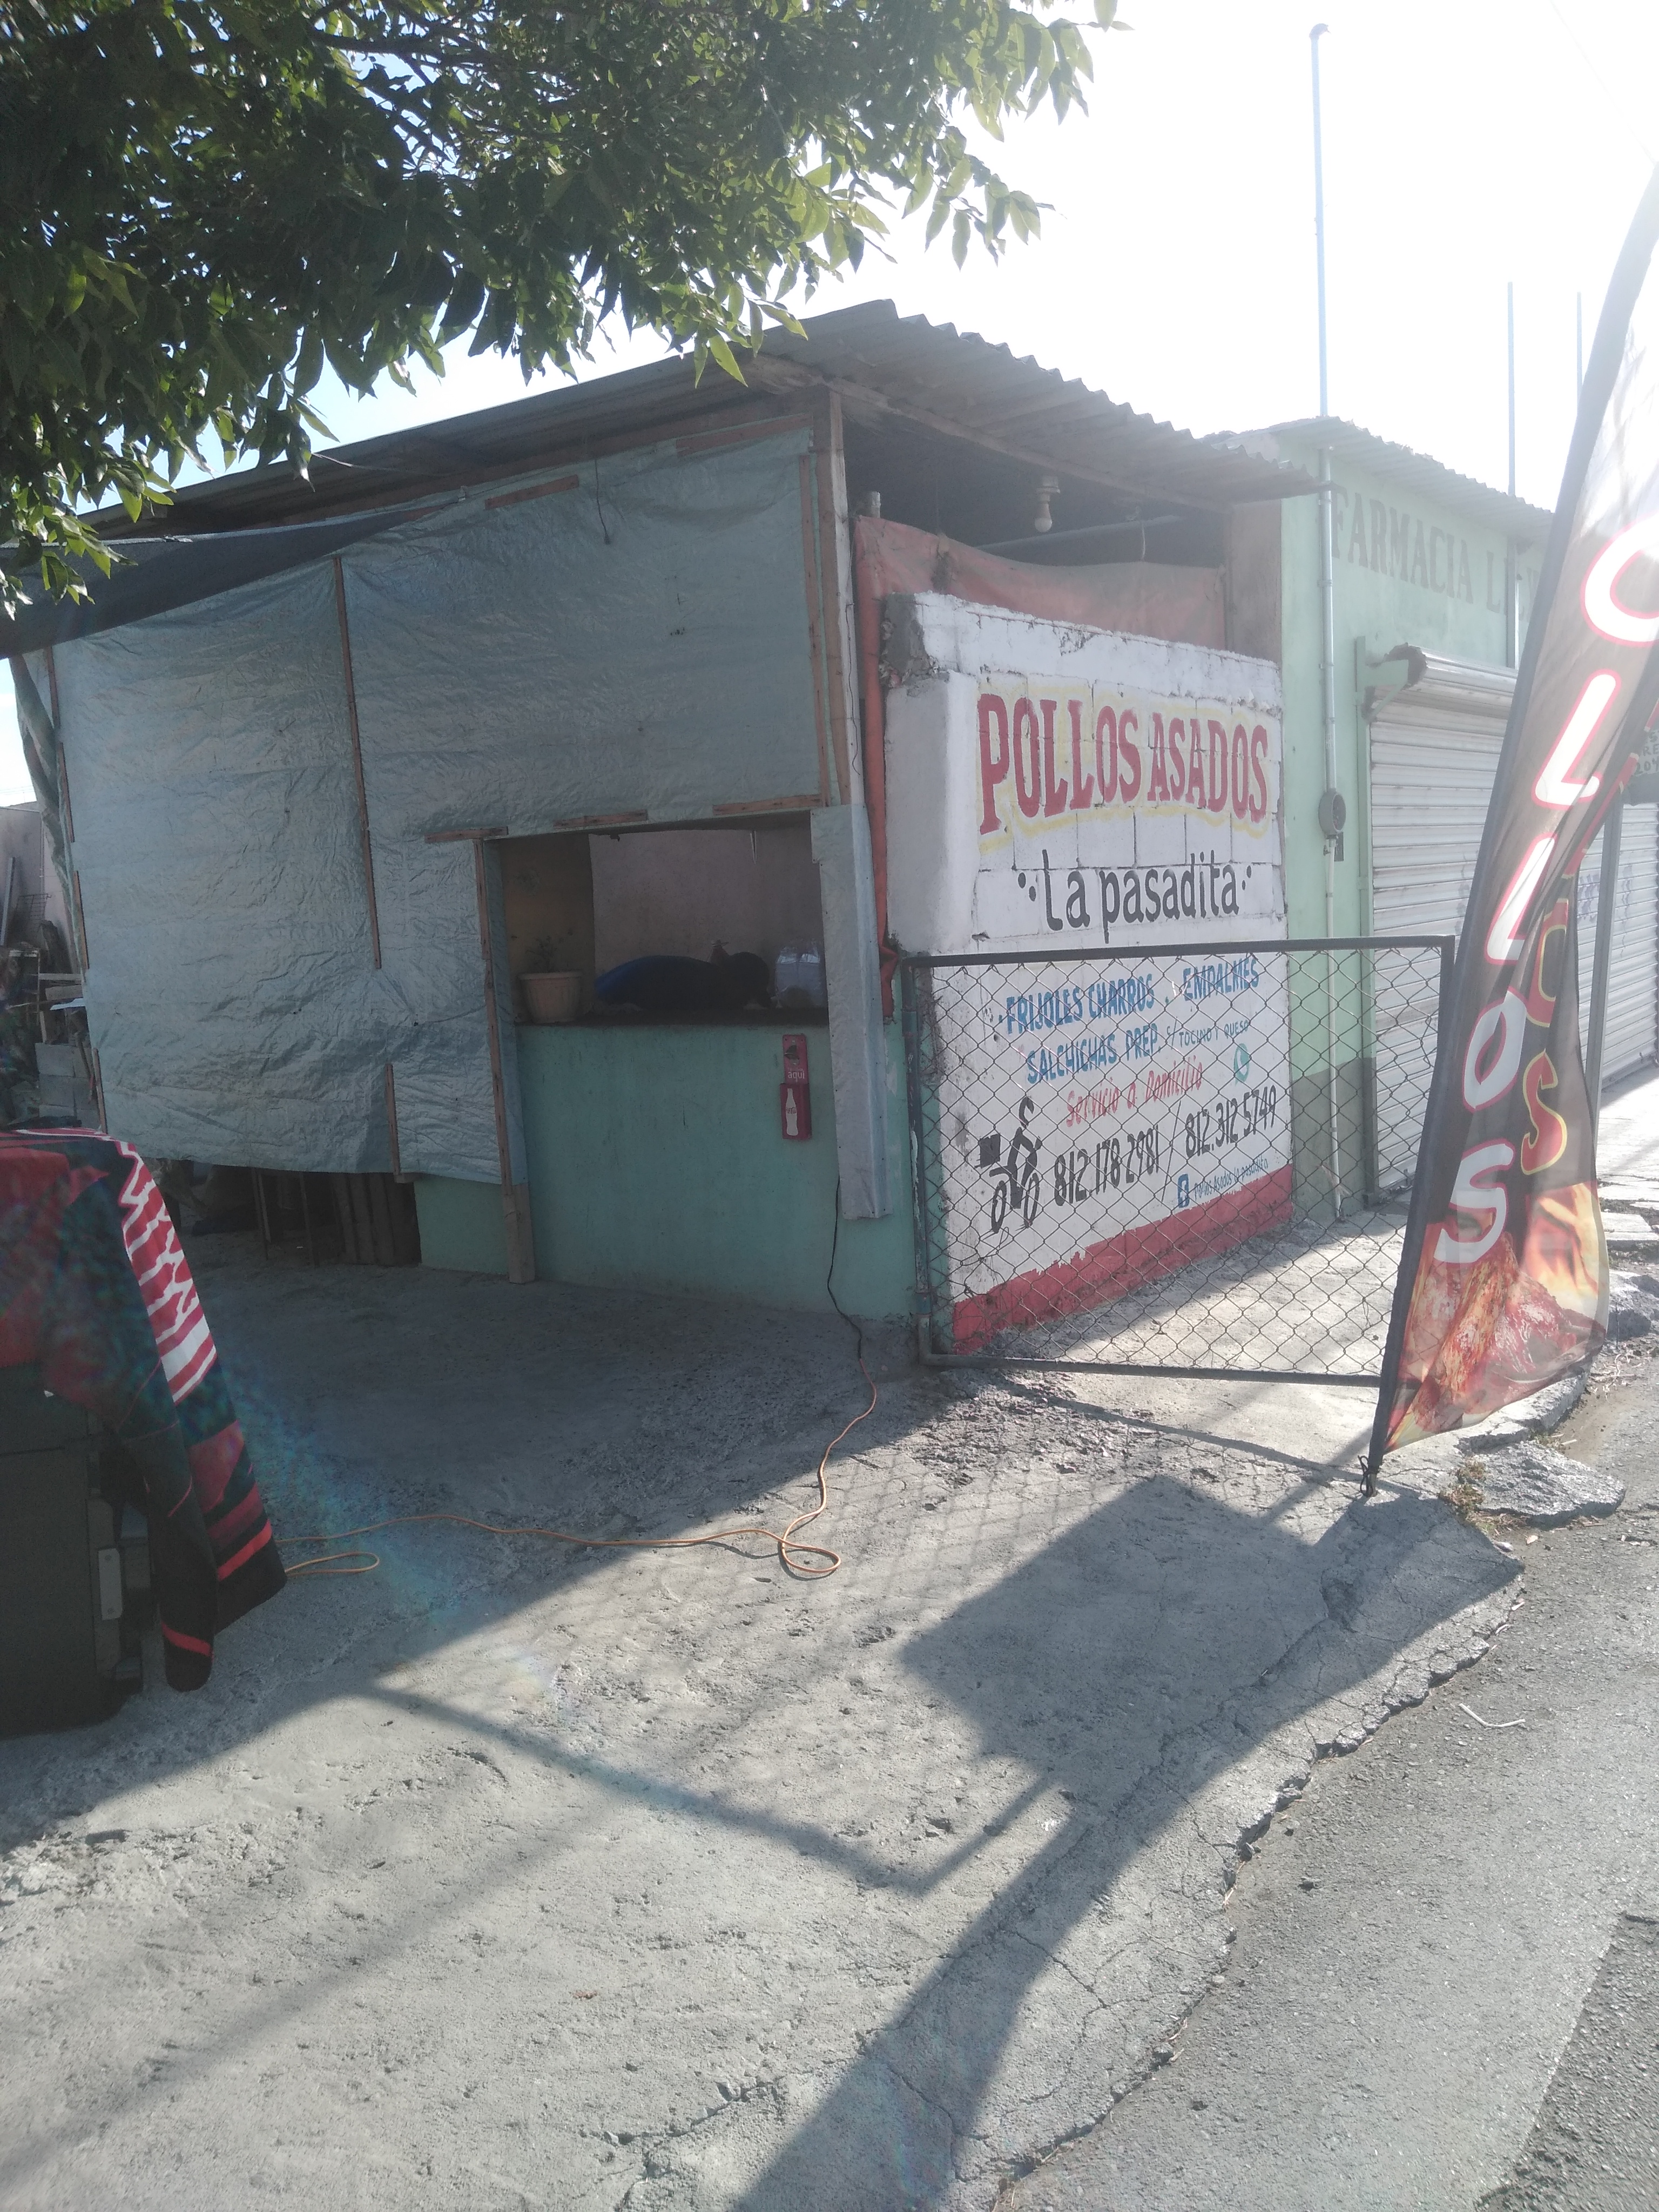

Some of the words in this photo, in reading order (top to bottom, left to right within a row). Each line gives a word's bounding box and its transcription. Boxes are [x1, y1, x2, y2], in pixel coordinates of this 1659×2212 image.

[1331, 486, 1474, 604] FARMACIA
[977, 693, 1142, 835] POLLOS
[1147, 712, 1268, 823] ASADOS
[1041, 849, 1091, 931] La
[1099, 850, 1239, 944] pasadita
[1006, 986, 1083, 1034] FRIJOLES
[1089, 974, 1155, 1019] CHARROS
[1183, 958, 1259, 1001] EMPALMES
[1027, 1034, 1117, 1084] SALCHICHAS
[1178, 1028, 1212, 1047] TOCINO
[1224, 1020, 1250, 1040] QUESO
[1066, 1077, 1120, 1128] Servicio
[1145, 1055, 1203, 1103] Domicilio
[1126, 1124, 1159, 1184] 2981
[1243, 1084, 1277, 1137] 5749
